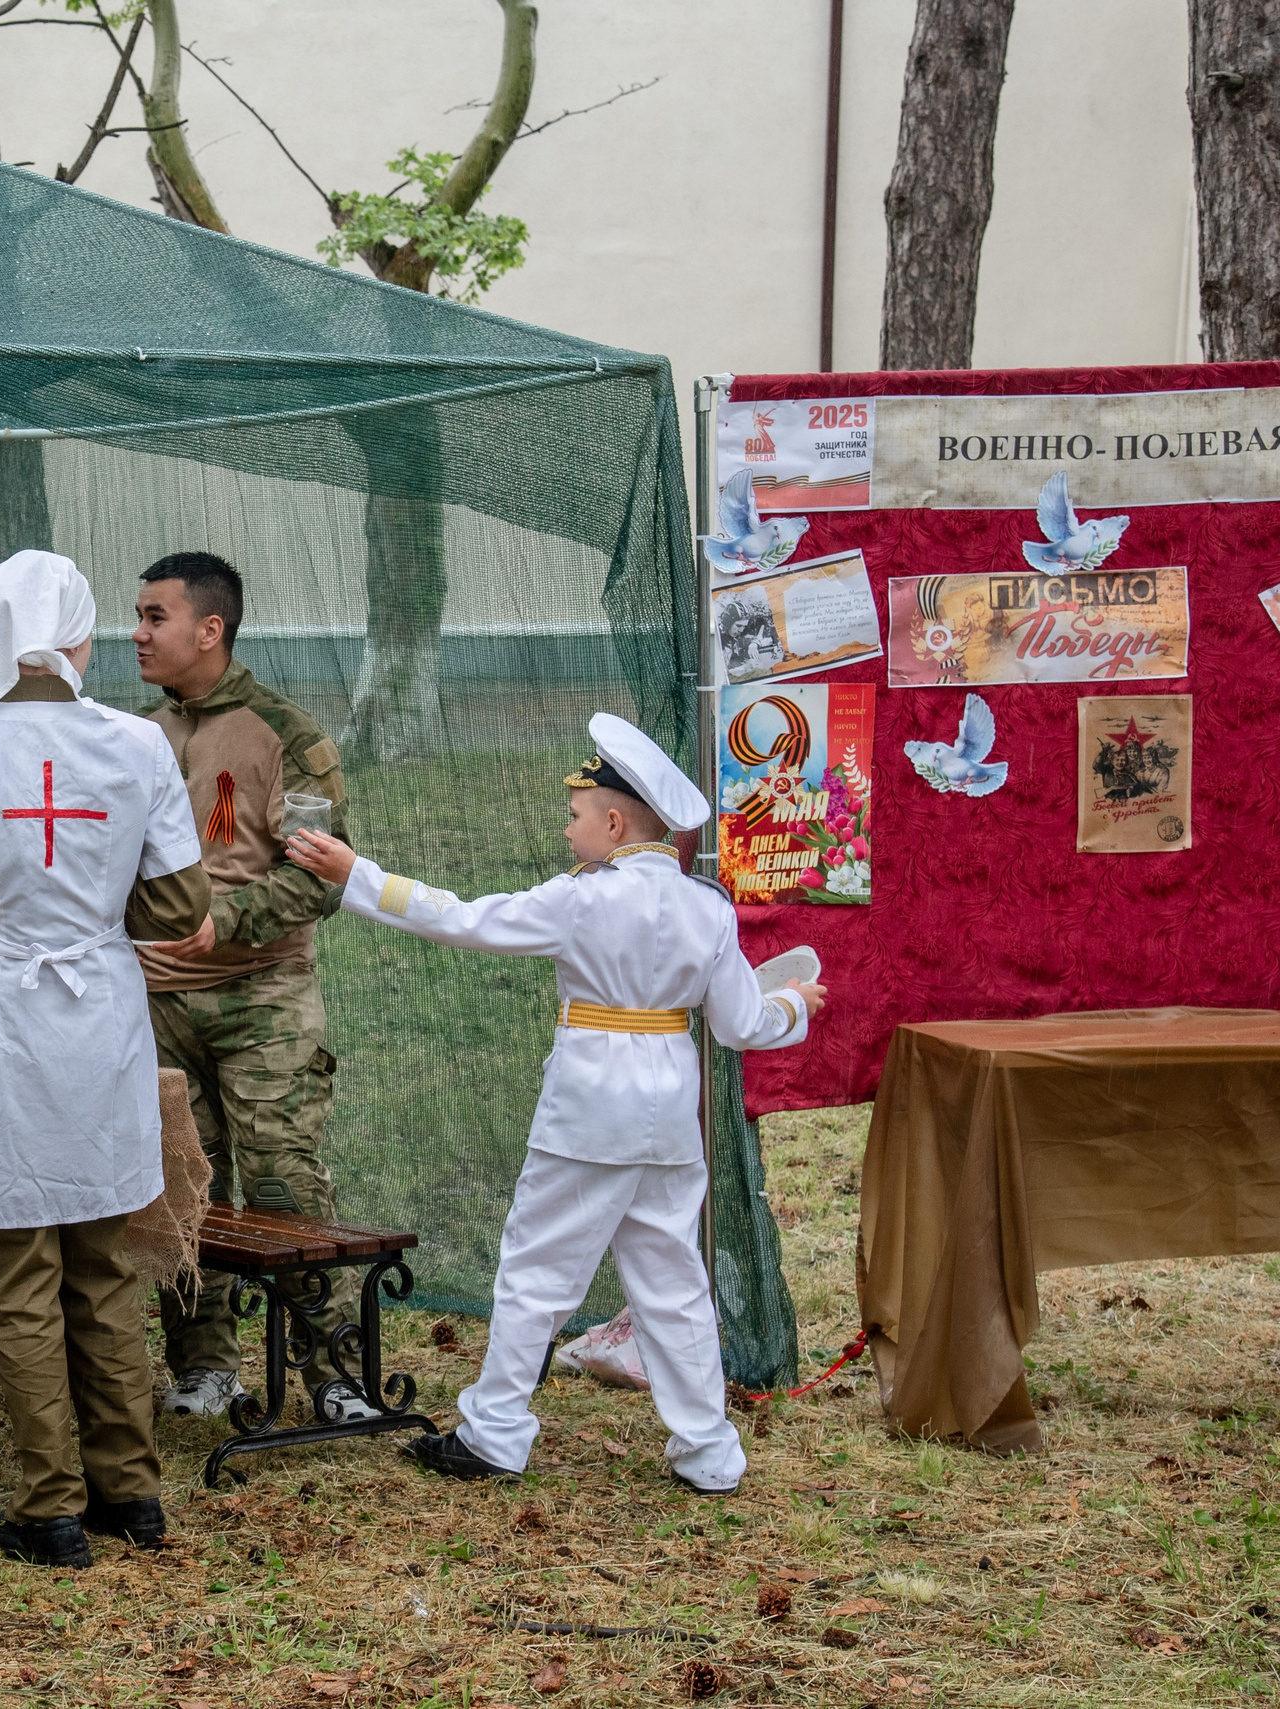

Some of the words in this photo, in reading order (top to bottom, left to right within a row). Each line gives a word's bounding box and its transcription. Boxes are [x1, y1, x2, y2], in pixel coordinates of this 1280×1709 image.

[808, 404, 868, 429] 2025
[745, 438, 762, 453] 80
[815, 440, 867, 450] ЗАЩИТНИКА
[851, 431, 867, 439] ГОД
[745, 454, 776, 462] ПОБЕДА!
[820, 450, 867, 459] ОТЕЧЕСТВА
[938, 434, 1106, 461] ВОЕННО-
[991, 574, 1155, 607] ПИСЬМО
[1004, 599, 1169, 678] Победы
[772, 791, 830, 823] МАЯ
[1131, 794, 1177, 809] привет
[733, 837, 744, 854] С
[749, 833, 790, 855] ДНЕМ
[756, 847, 820, 871] ВЕЛИКОЙ
[736, 871, 799, 892] ПОБЕДЫ!
